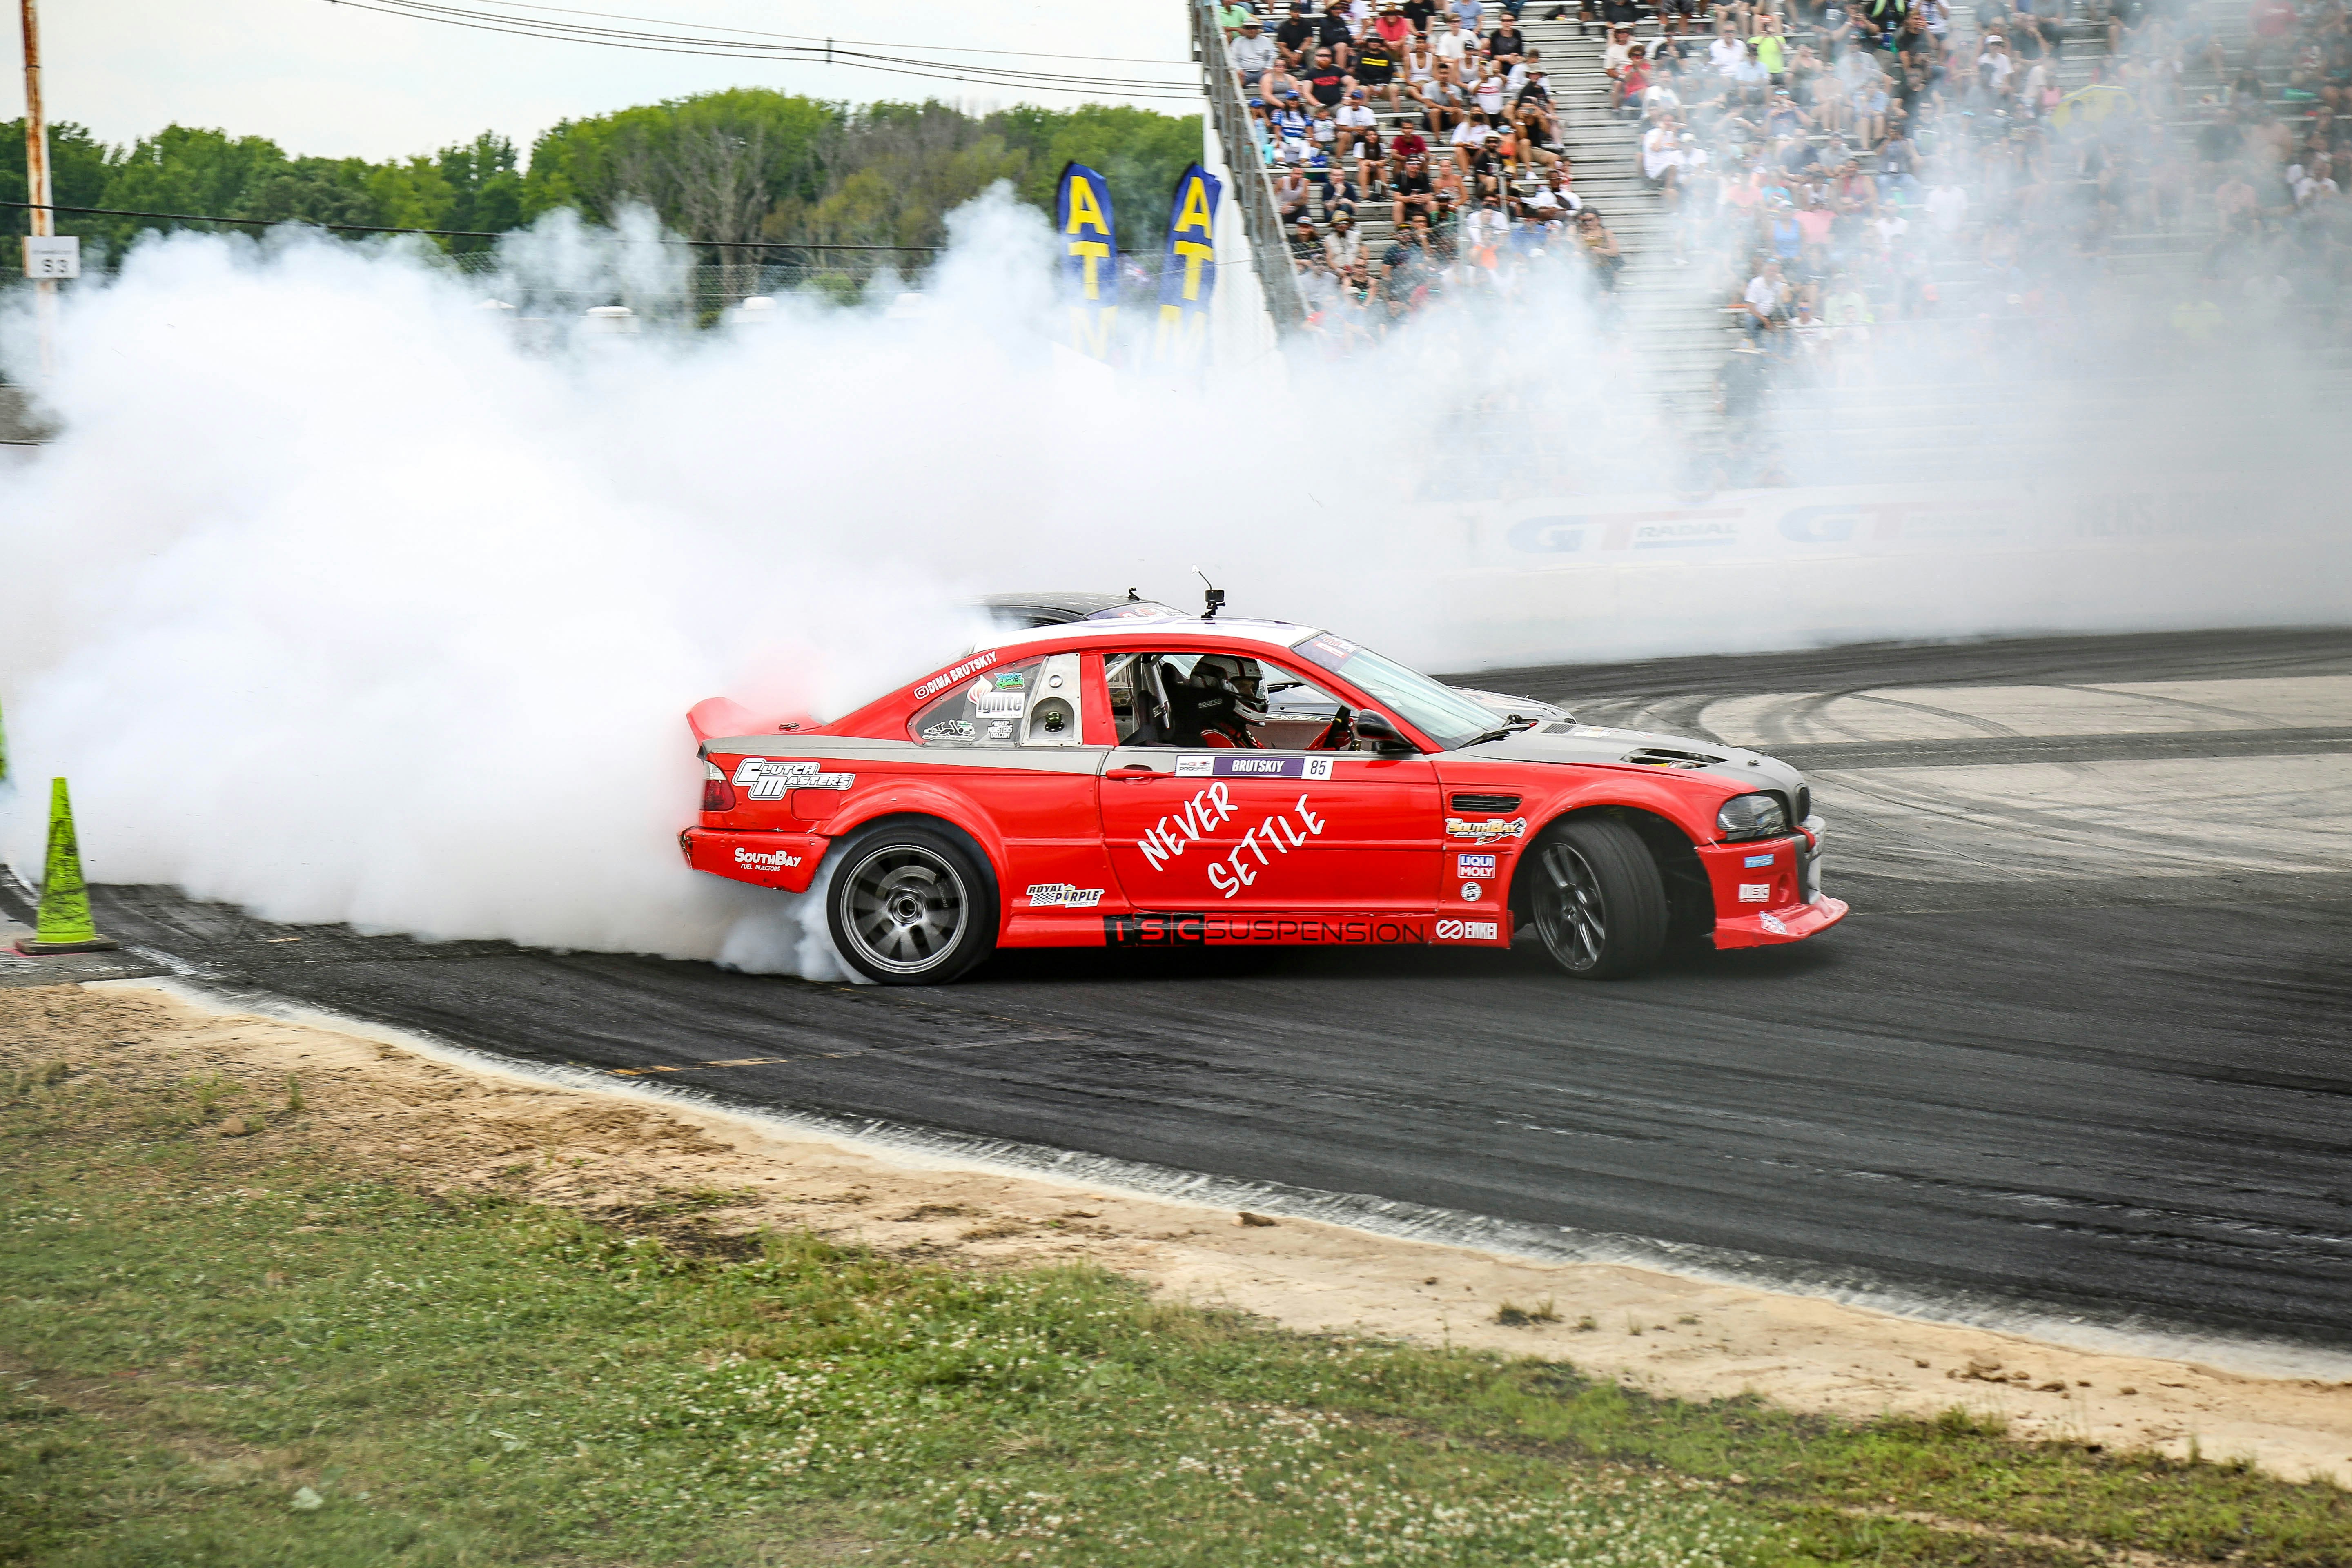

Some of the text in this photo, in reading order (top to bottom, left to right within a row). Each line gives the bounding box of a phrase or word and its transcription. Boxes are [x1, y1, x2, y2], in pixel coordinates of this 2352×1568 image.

[927, 673, 952, 694] DIMA
[949, 651, 997, 682] BRUTSKIY
[978, 693, 1022, 713] ignite
[1198, 698, 1222, 708] sparco
[737, 762, 817, 782] CLUTCH
[1231, 760, 1327, 775] BRUTSKIY 85
[753, 775, 851, 796] MASTERS
[1137, 781, 1239, 871] NEVER
[1207, 793, 1326, 898] SETTLE
[1460, 856, 1493, 866] LIQUI
[1460, 866, 1494, 877] MOLY
[1029, 885, 1062, 894] ROYAL
[1054, 890, 1100, 903] PURPLE
[1206, 920, 1424, 942] SUSPENSION
[1464, 922, 1498, 940] ENKEI
